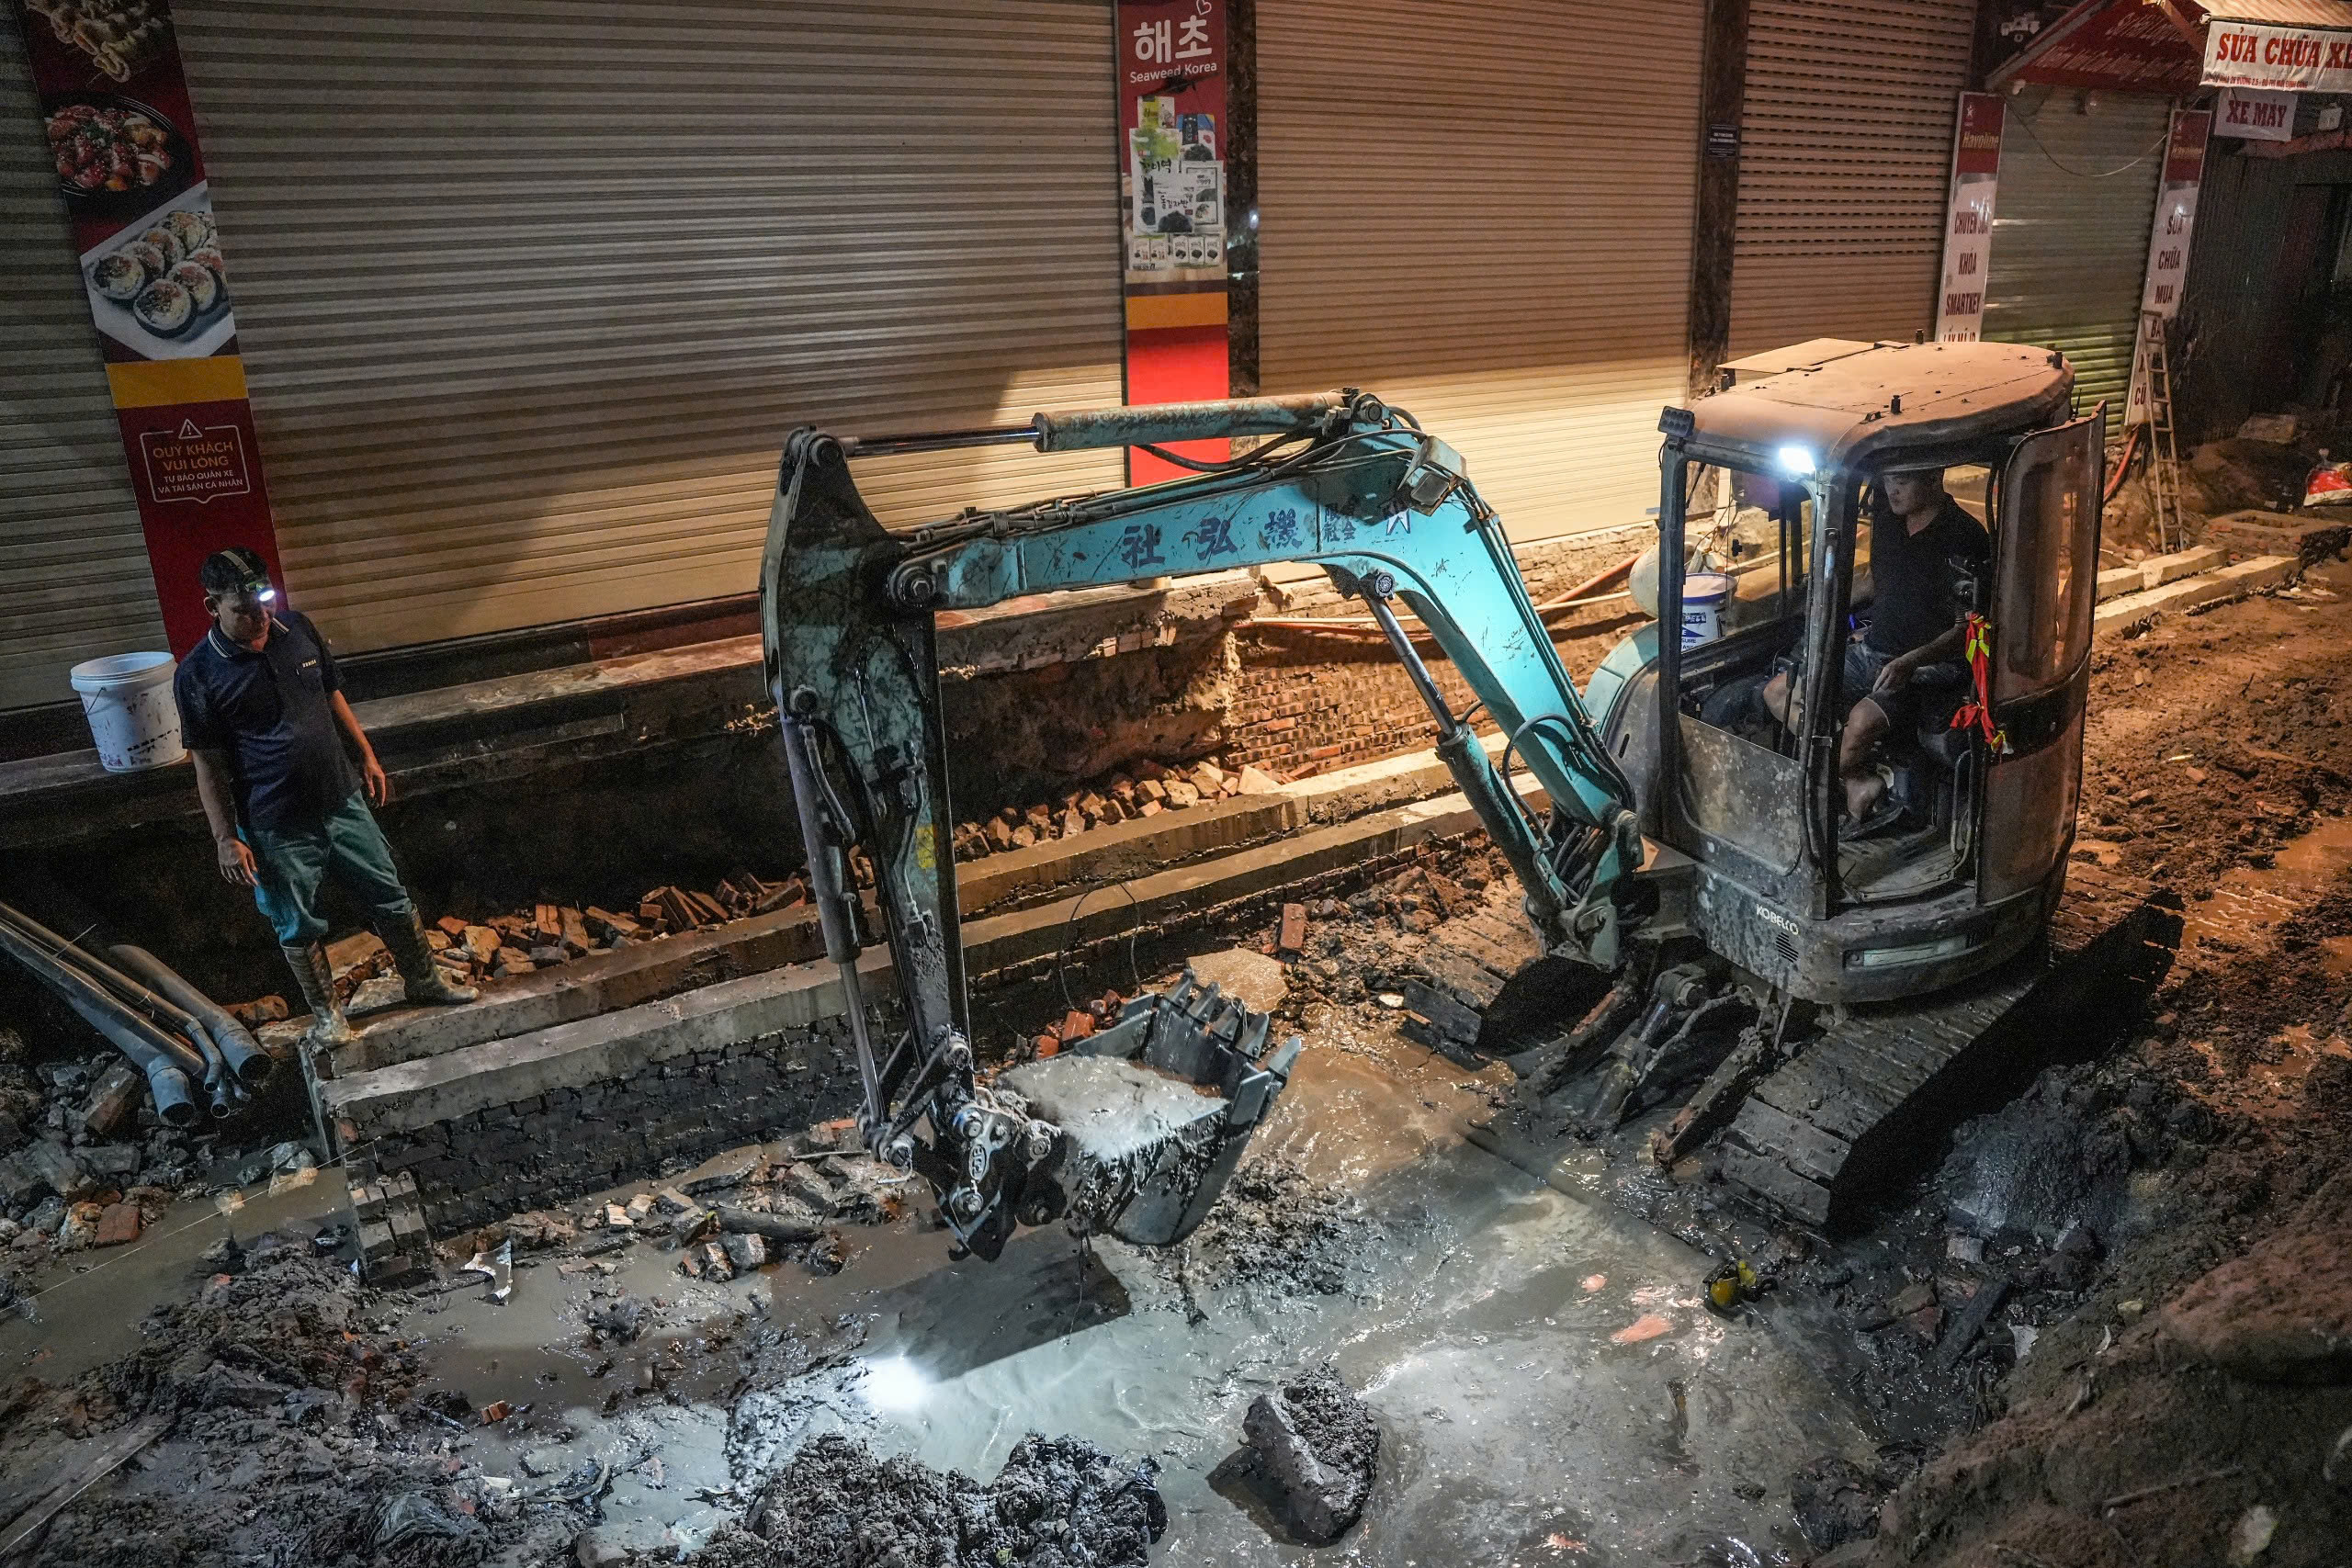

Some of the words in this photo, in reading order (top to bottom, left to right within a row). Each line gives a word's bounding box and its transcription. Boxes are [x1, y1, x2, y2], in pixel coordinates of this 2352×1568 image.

[1133, 15, 1213, 64] 해초
[2216, 26, 2258, 63] SỬA
[1129, 64, 1182, 84] Seaweed
[1184, 62, 1217, 76] Korea
[2225, 99, 2251, 125] XE
[1962, 130, 1999, 149] Havoline
[1945, 292, 1982, 316] SMARTKEY
[2154, 285, 2174, 304] MUA
[187, 441, 233, 457] KHÁCH
[163, 459, 187, 471] VUI
